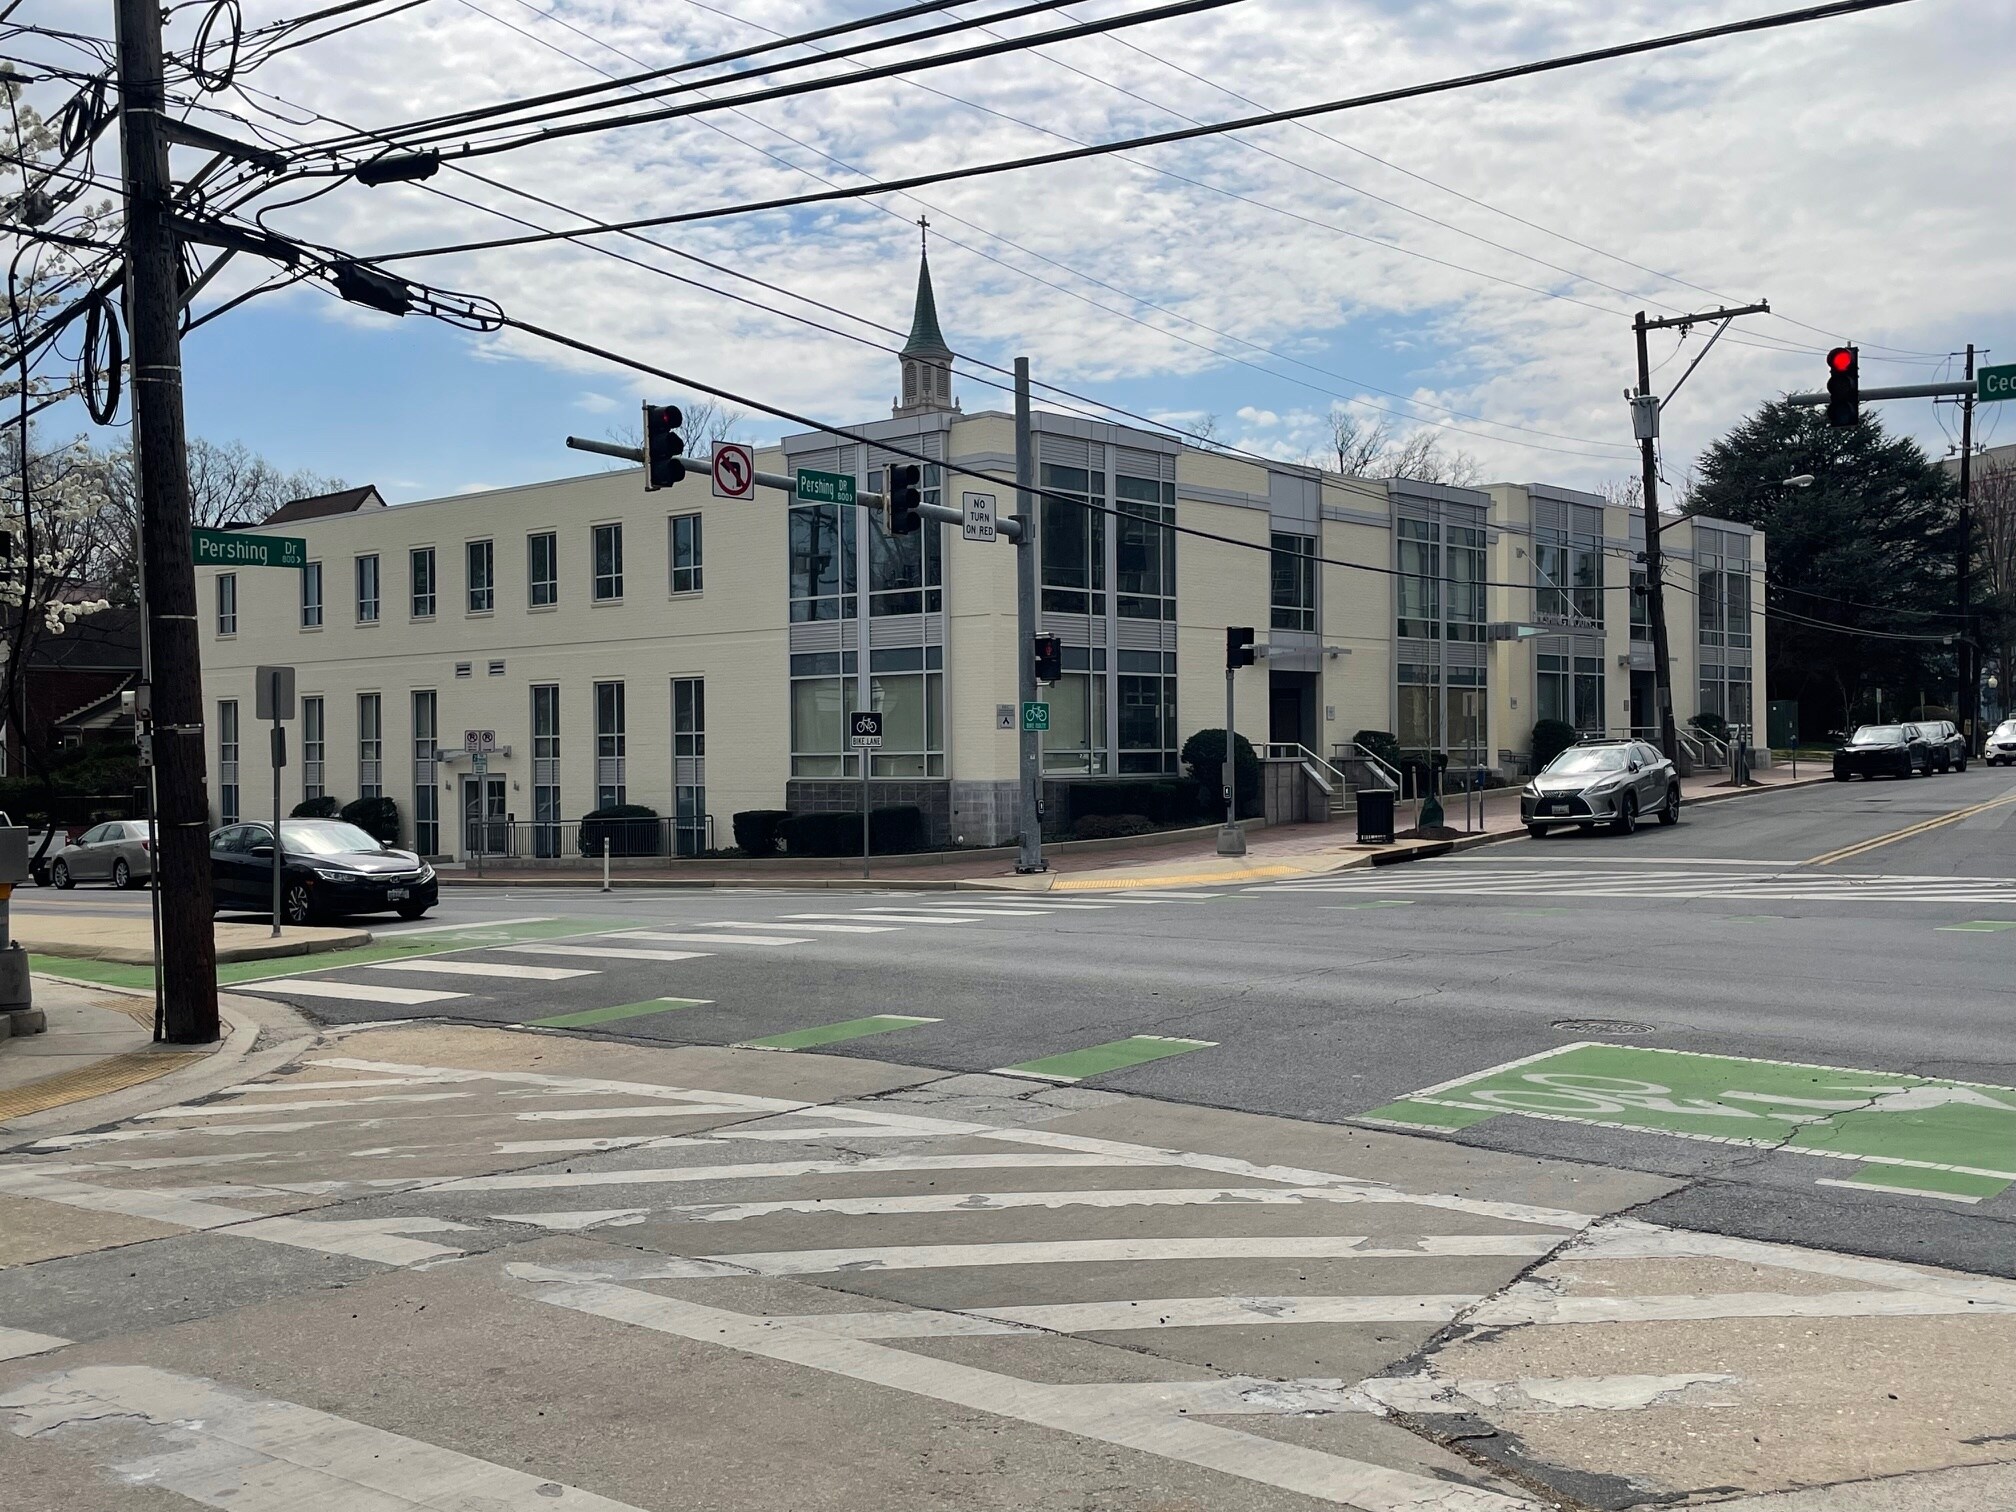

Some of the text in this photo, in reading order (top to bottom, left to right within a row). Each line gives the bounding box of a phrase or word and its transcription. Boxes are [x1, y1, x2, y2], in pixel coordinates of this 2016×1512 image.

[801, 476, 848, 500] Pershing DR
[973, 499, 986, 509] NO
[970, 511, 990, 522] TURN
[966, 524, 994, 536] ON RED
[199, 538, 297, 566] Pershing Dr
[281, 555, 296, 564] 800
[853, 737, 881, 746] BIKE LANE
